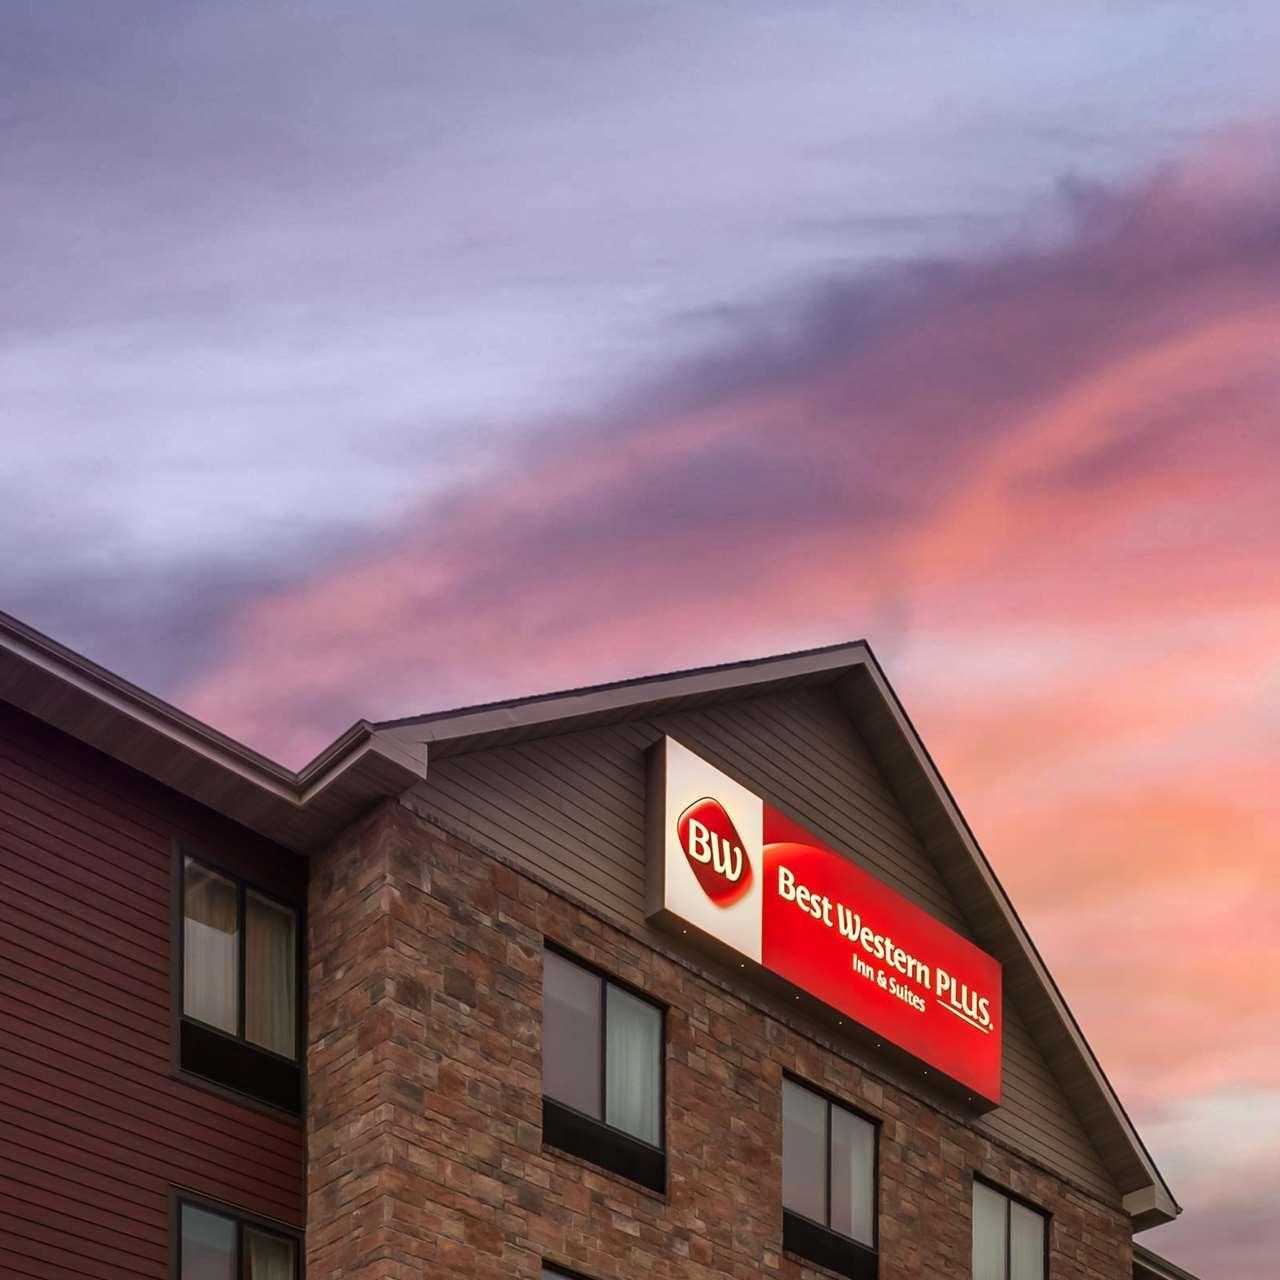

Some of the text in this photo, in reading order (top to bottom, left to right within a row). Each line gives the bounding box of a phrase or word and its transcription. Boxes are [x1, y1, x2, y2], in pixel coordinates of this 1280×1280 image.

[687, 817, 743, 882] BW
[778, 864, 834, 928] Best
[837, 902, 931, 990] Western
[852, 952, 926, 1013] Inn & Suites
